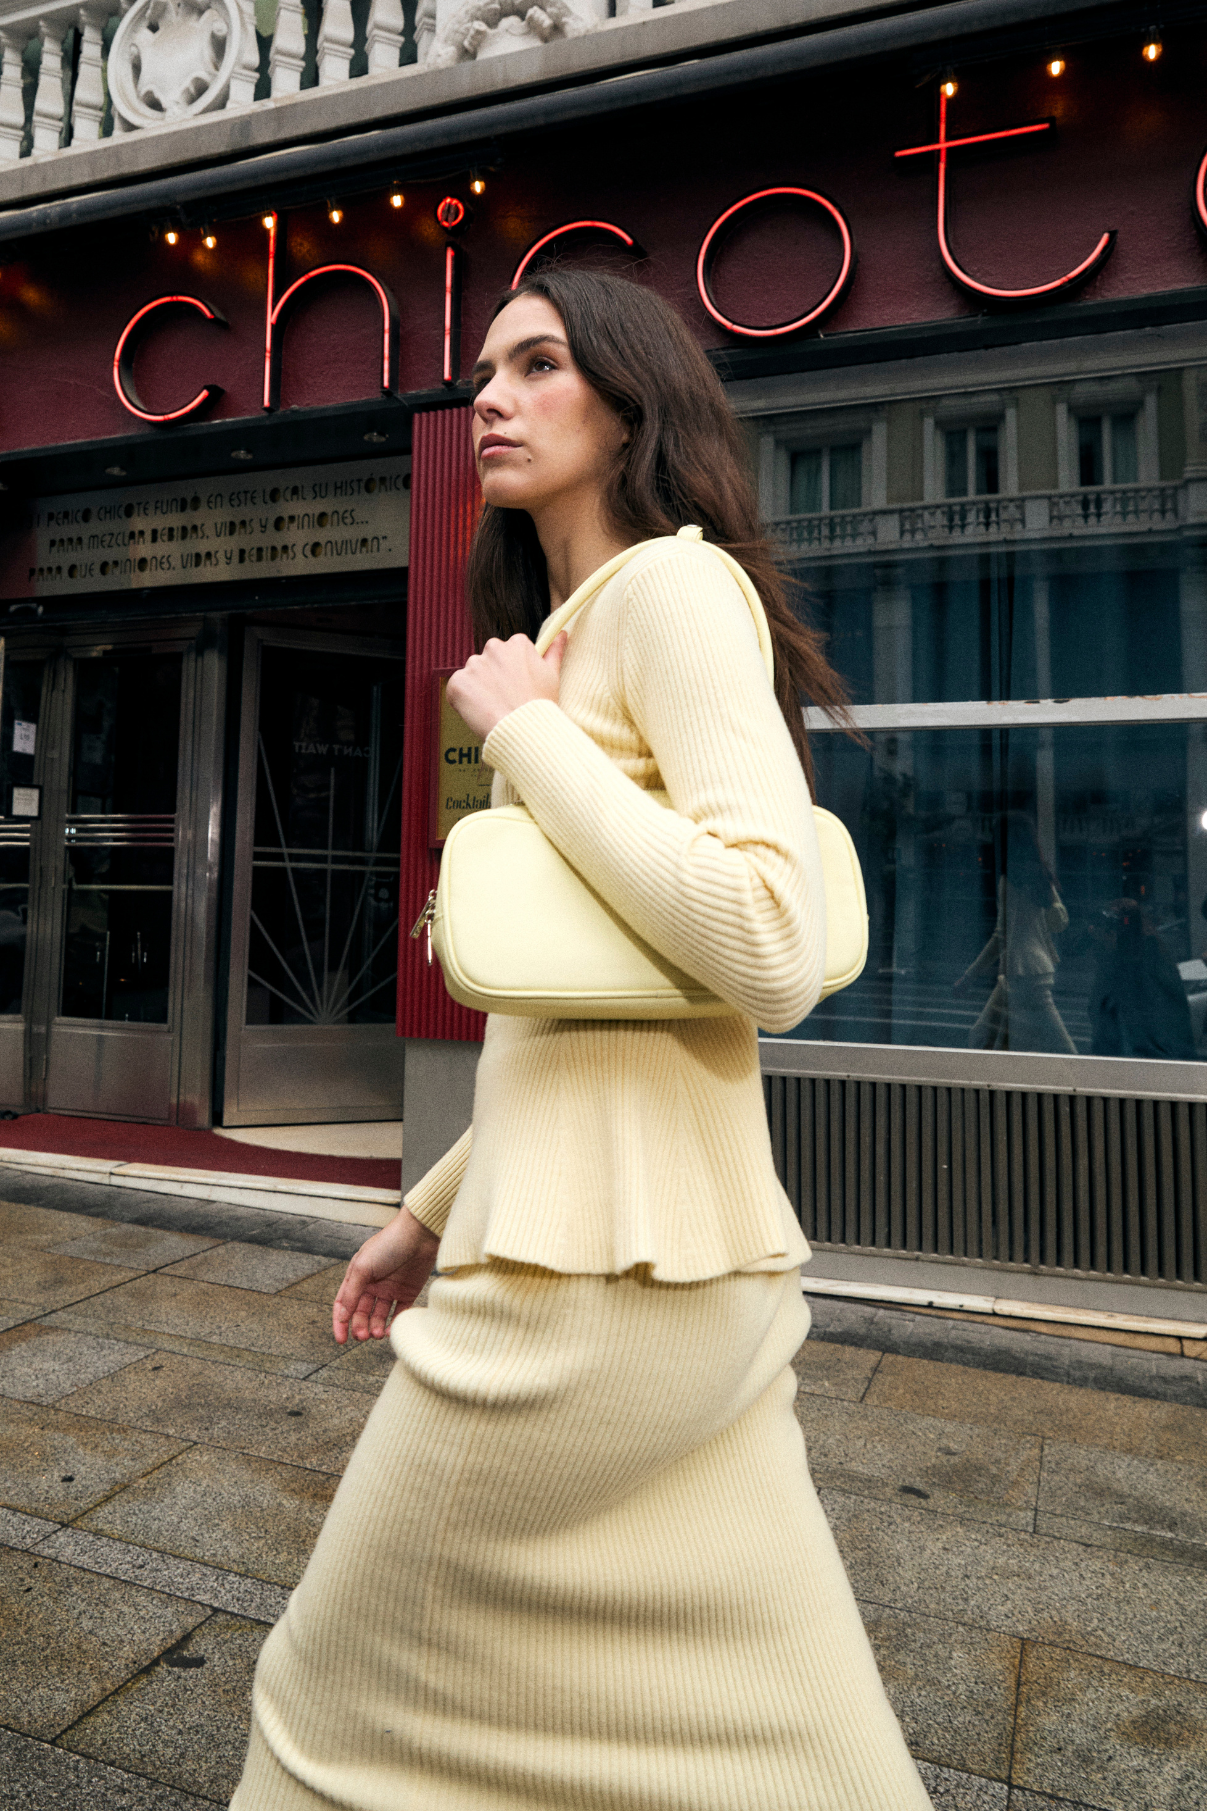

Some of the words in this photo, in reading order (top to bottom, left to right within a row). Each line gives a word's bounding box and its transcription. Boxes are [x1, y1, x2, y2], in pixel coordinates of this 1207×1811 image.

[112, 86, 1207, 424] chicot
[47, 507, 92, 527] PERICO
[97, 501, 149, 521] CHICOTE
[154, 491, 201, 516] FUNDÓ
[207, 493, 223, 510] EN
[229, 490, 257, 507] ESTE
[262, 485, 307, 504] LOCAL
[312, 482, 328, 500] SU
[334, 473, 411, 498] HISTÓRICO
[49, 536, 83, 554] PARA
[88, 530, 146, 550] MEZCLAR
[214, 519, 254, 538] VIDAS
[259, 517, 268, 534] Y
[28, 565, 62, 584] PARA
[68, 562, 95, 579] QUE
[180, 550, 219, 570] VIDAS
[225, 549, 233, 565] Y
[238, 543, 296, 564] BEBIDAS
[444, 746, 479, 764] CHI
